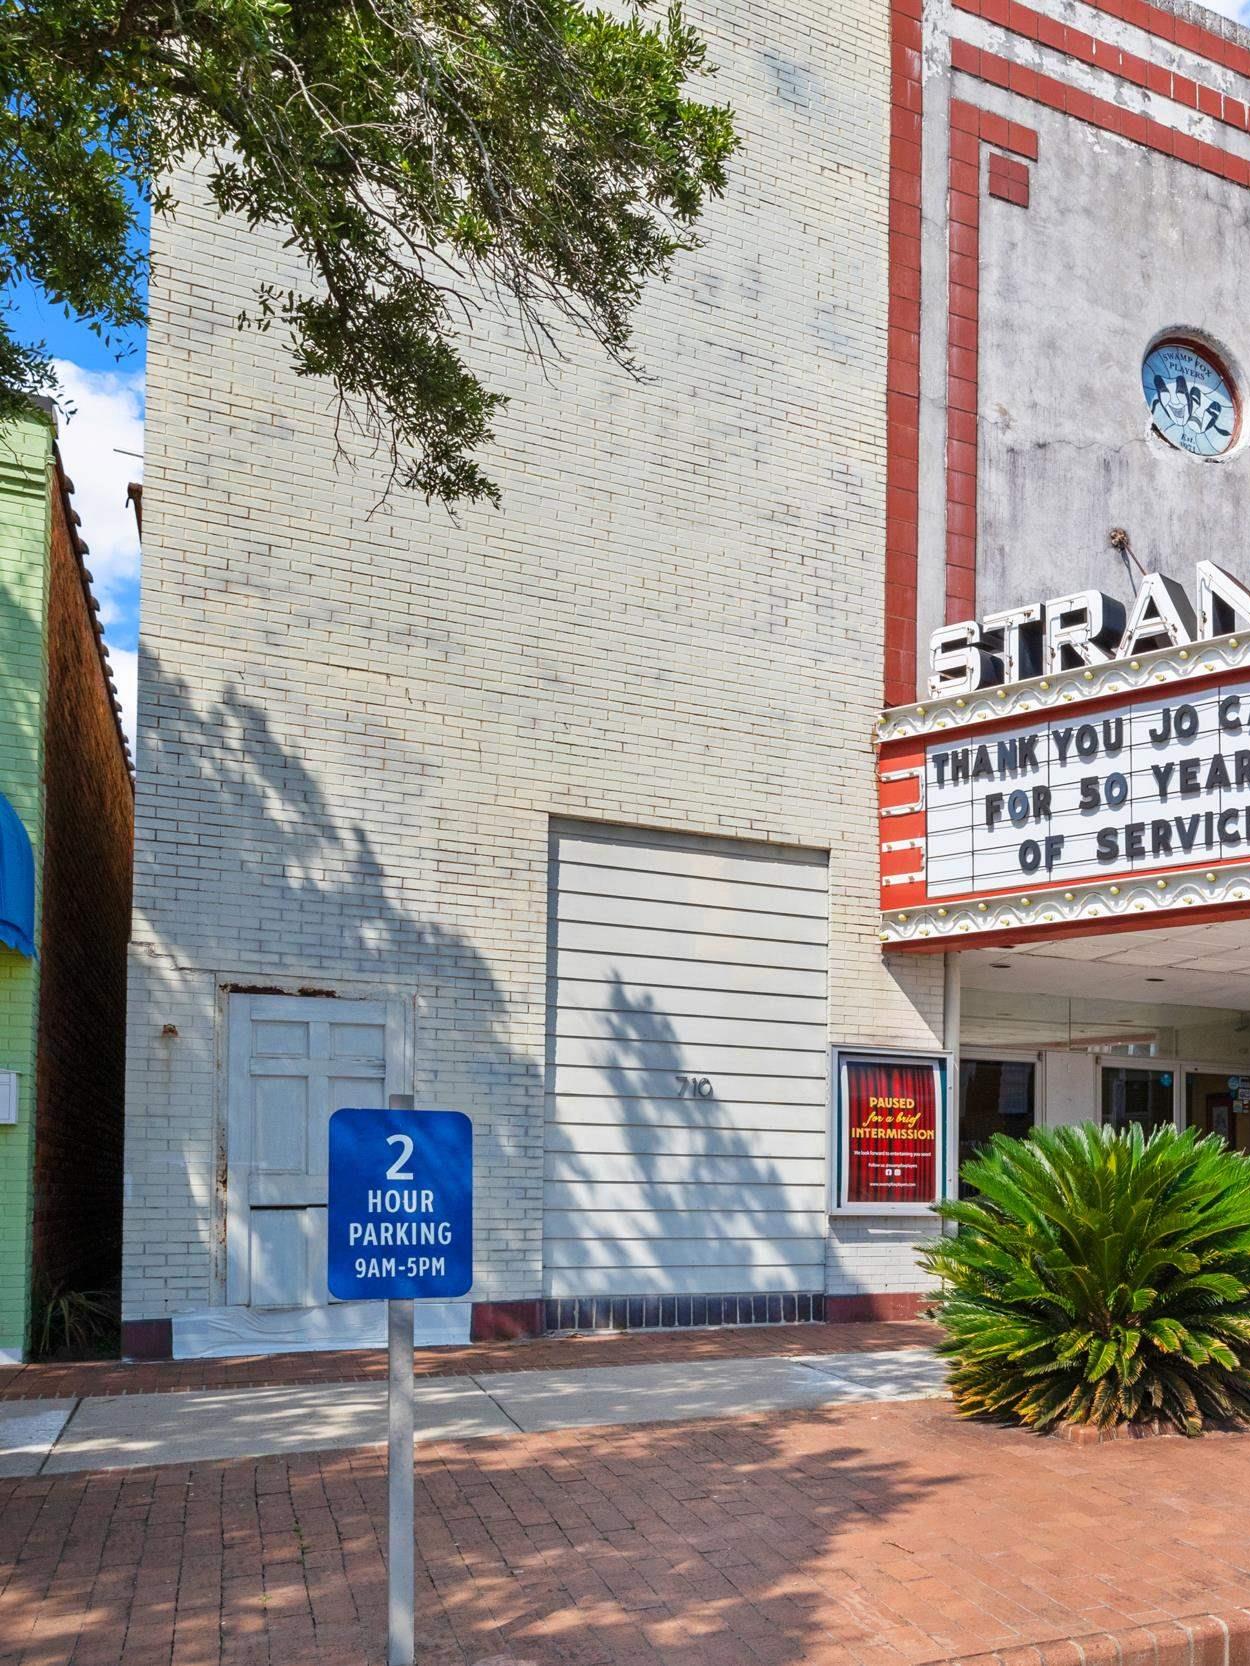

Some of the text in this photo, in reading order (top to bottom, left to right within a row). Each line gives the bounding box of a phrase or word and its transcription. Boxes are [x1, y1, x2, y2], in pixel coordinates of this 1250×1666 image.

[1163, 352, 1212, 377] SWAMP FOX
[1169, 362, 1205, 380] PLAYERS
[932, 734, 1039, 785] THANK
[1052, 717, 1123, 762] YOU
[1150, 704, 1199, 744] JO
[985, 785, 1051, 826] FOR
[1079, 772, 1128, 810] 50
[1019, 834, 1064, 872] OF
[675, 1076, 713, 1097] 710
[869, 1097, 915, 1109] PAUSED
[862, 1111, 921, 1128] for a brief
[851, 1127, 935, 1140] INTERMISSION
[386, 1134, 414, 1180] 2
[368, 1190, 434, 1213] HOUR
[349, 1222, 452, 1246] PARKING
[355, 1256, 445, 1278] 9AM-5PM
